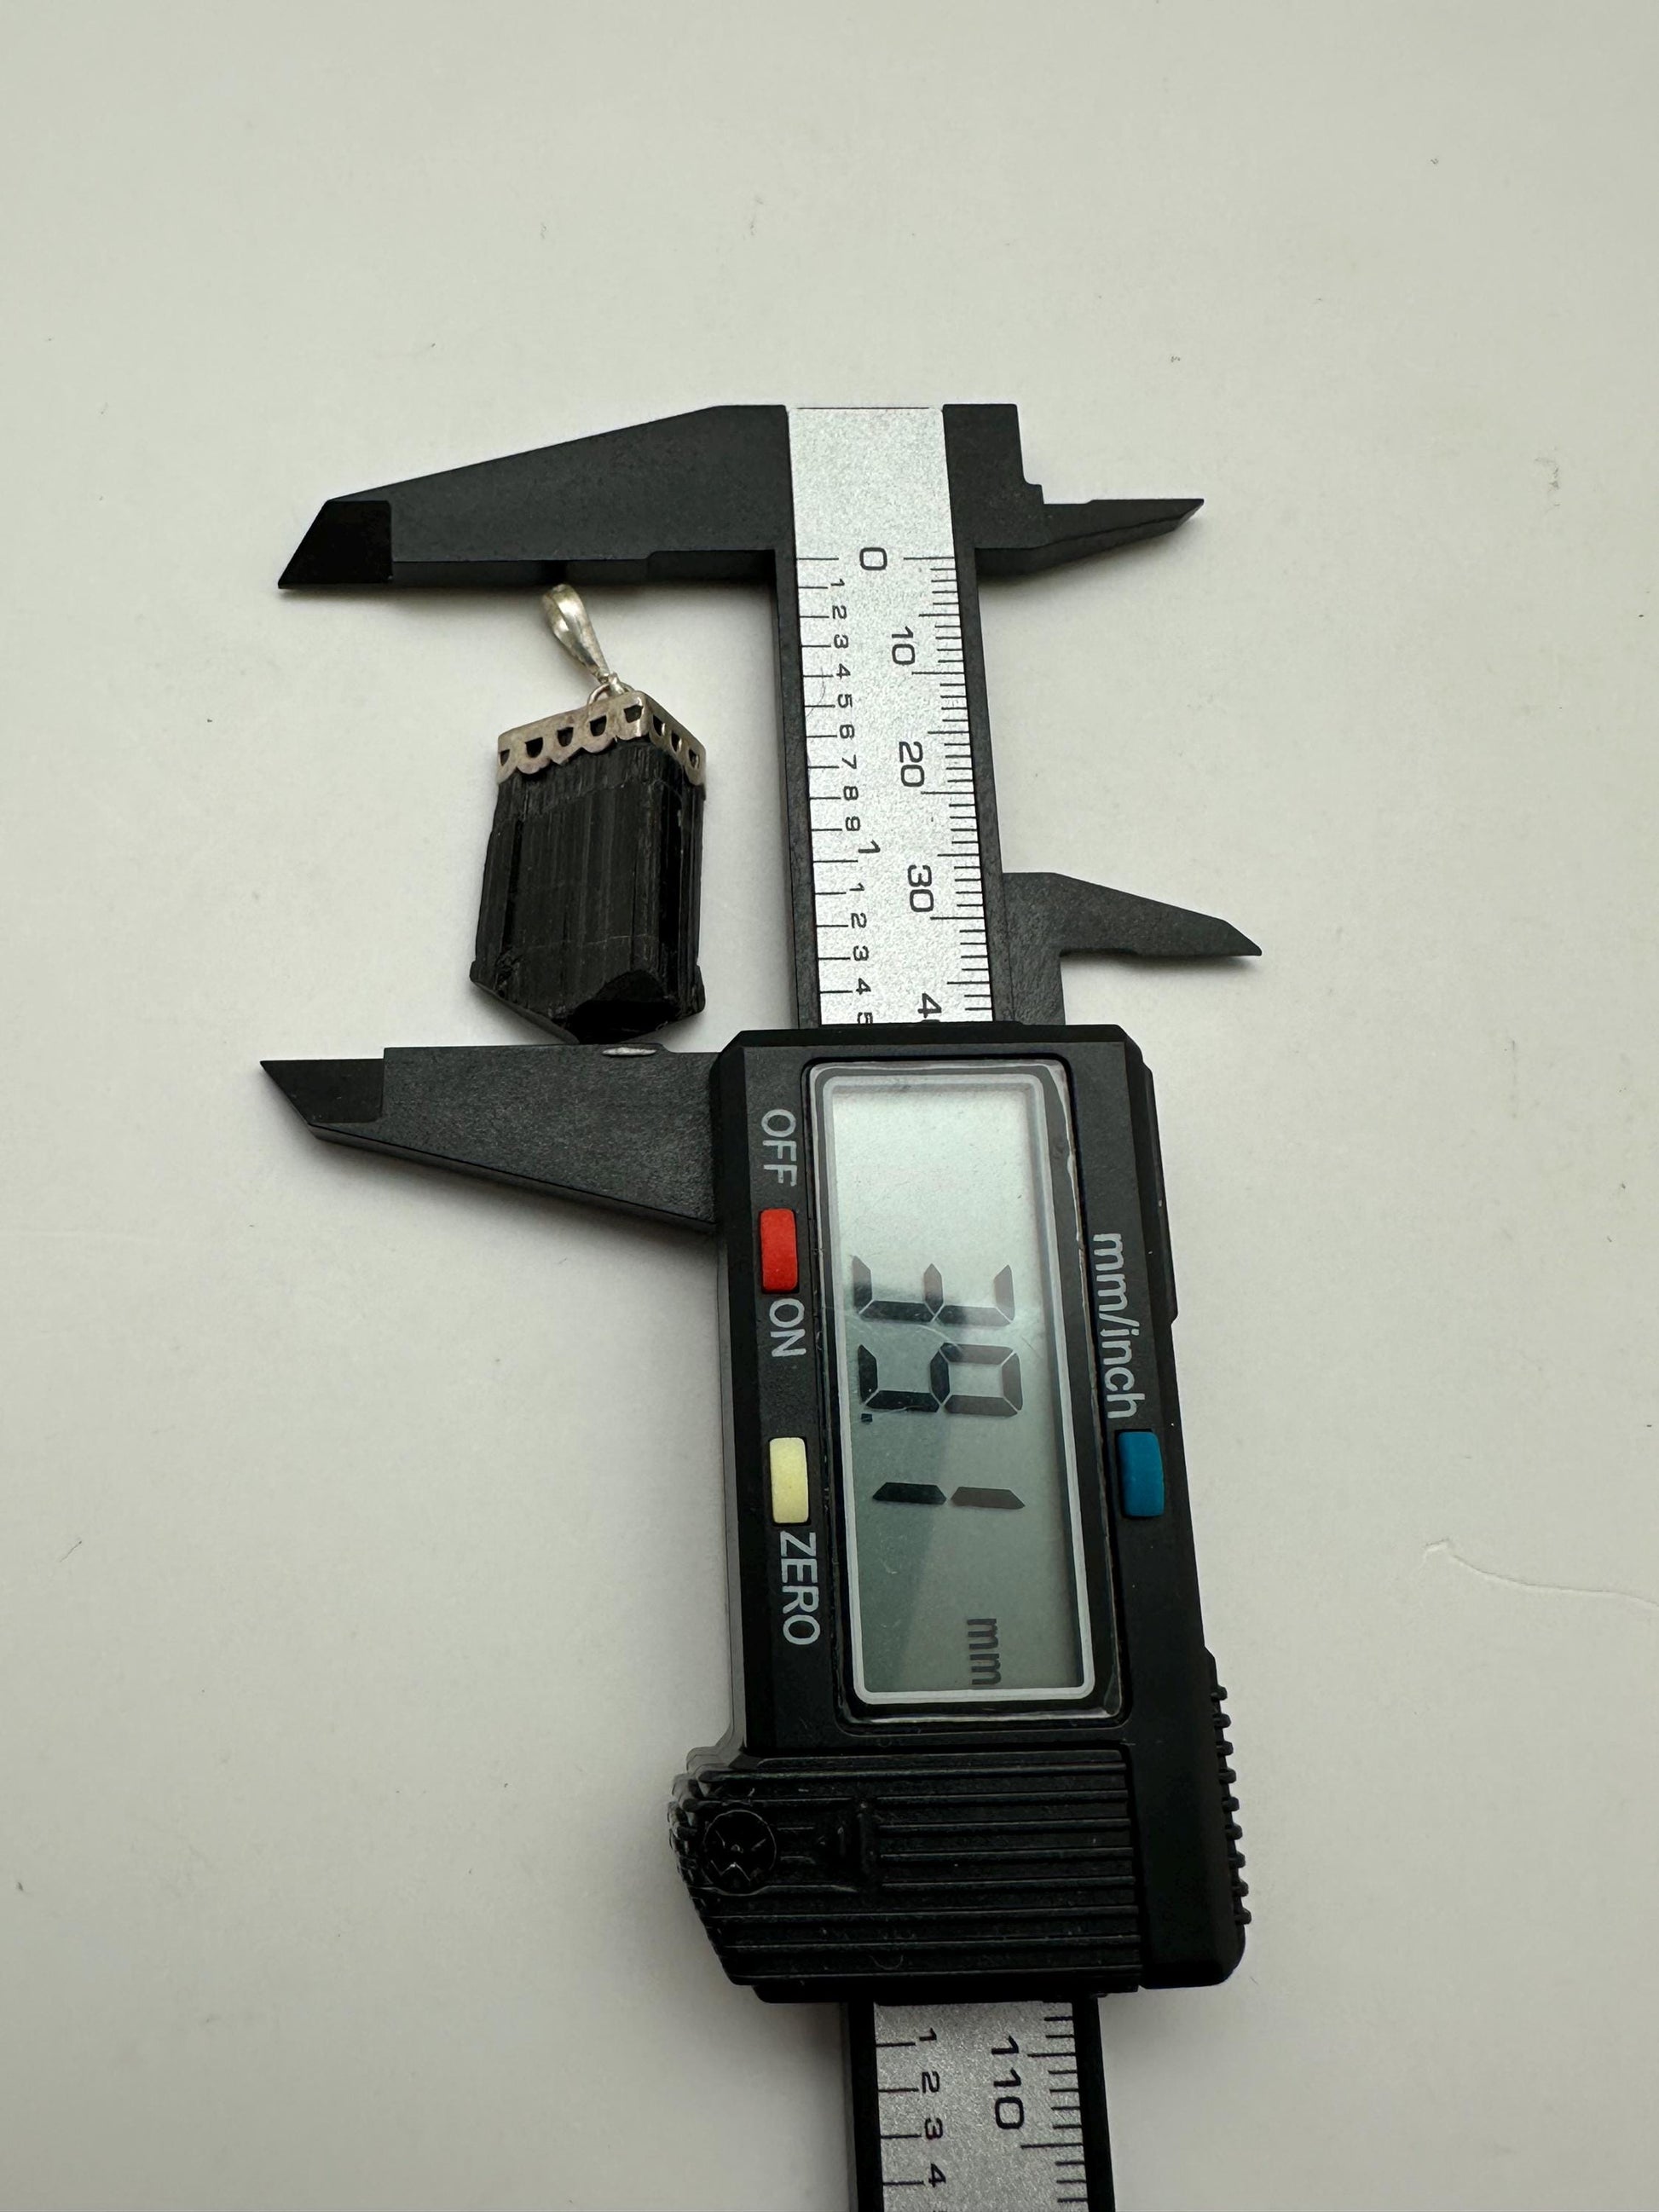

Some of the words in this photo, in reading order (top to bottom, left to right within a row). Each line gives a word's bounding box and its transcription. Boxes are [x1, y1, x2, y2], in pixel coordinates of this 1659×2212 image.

[859, 547, 887, 570] 0
[830, 578, 845, 587] 1
[832, 605, 847, 620] 2
[834, 634, 849, 649] 3
[892, 626, 916, 666] 10
[835, 663, 851, 679] 4
[837, 694, 853, 708] 5
[840, 725, 855, 740] 6
[841, 754, 857, 770] 7
[899, 741, 925, 788] 20
[843, 786, 858, 801] 8
[845, 816, 861, 832] 9
[858, 840, 881, 854] 1
[849, 882, 865, 892] 1
[907, 864, 934, 912] 30
[851, 912, 867, 928] 2
[853, 945, 869, 962] 3
[856, 978, 871, 995] 4
[917, 992, 942, 1023] 4
[761, 1109, 797, 1187] OFF
[770, 1297, 806, 1358] ON
[1093, 1233, 1145, 1418] mm/inch
[852, 1256, 1026, 1509] 39.1
[967, 1618, 1001, 1686] mm
[779, 1531, 821, 1645] ZERO
[919, 2028, 937, 2042] 1
[922, 2071, 940, 2094] 2
[991, 2035, 1024, 2129] 110
[924, 2117, 943, 2140] 3
[928, 2163, 946, 2188] 4
